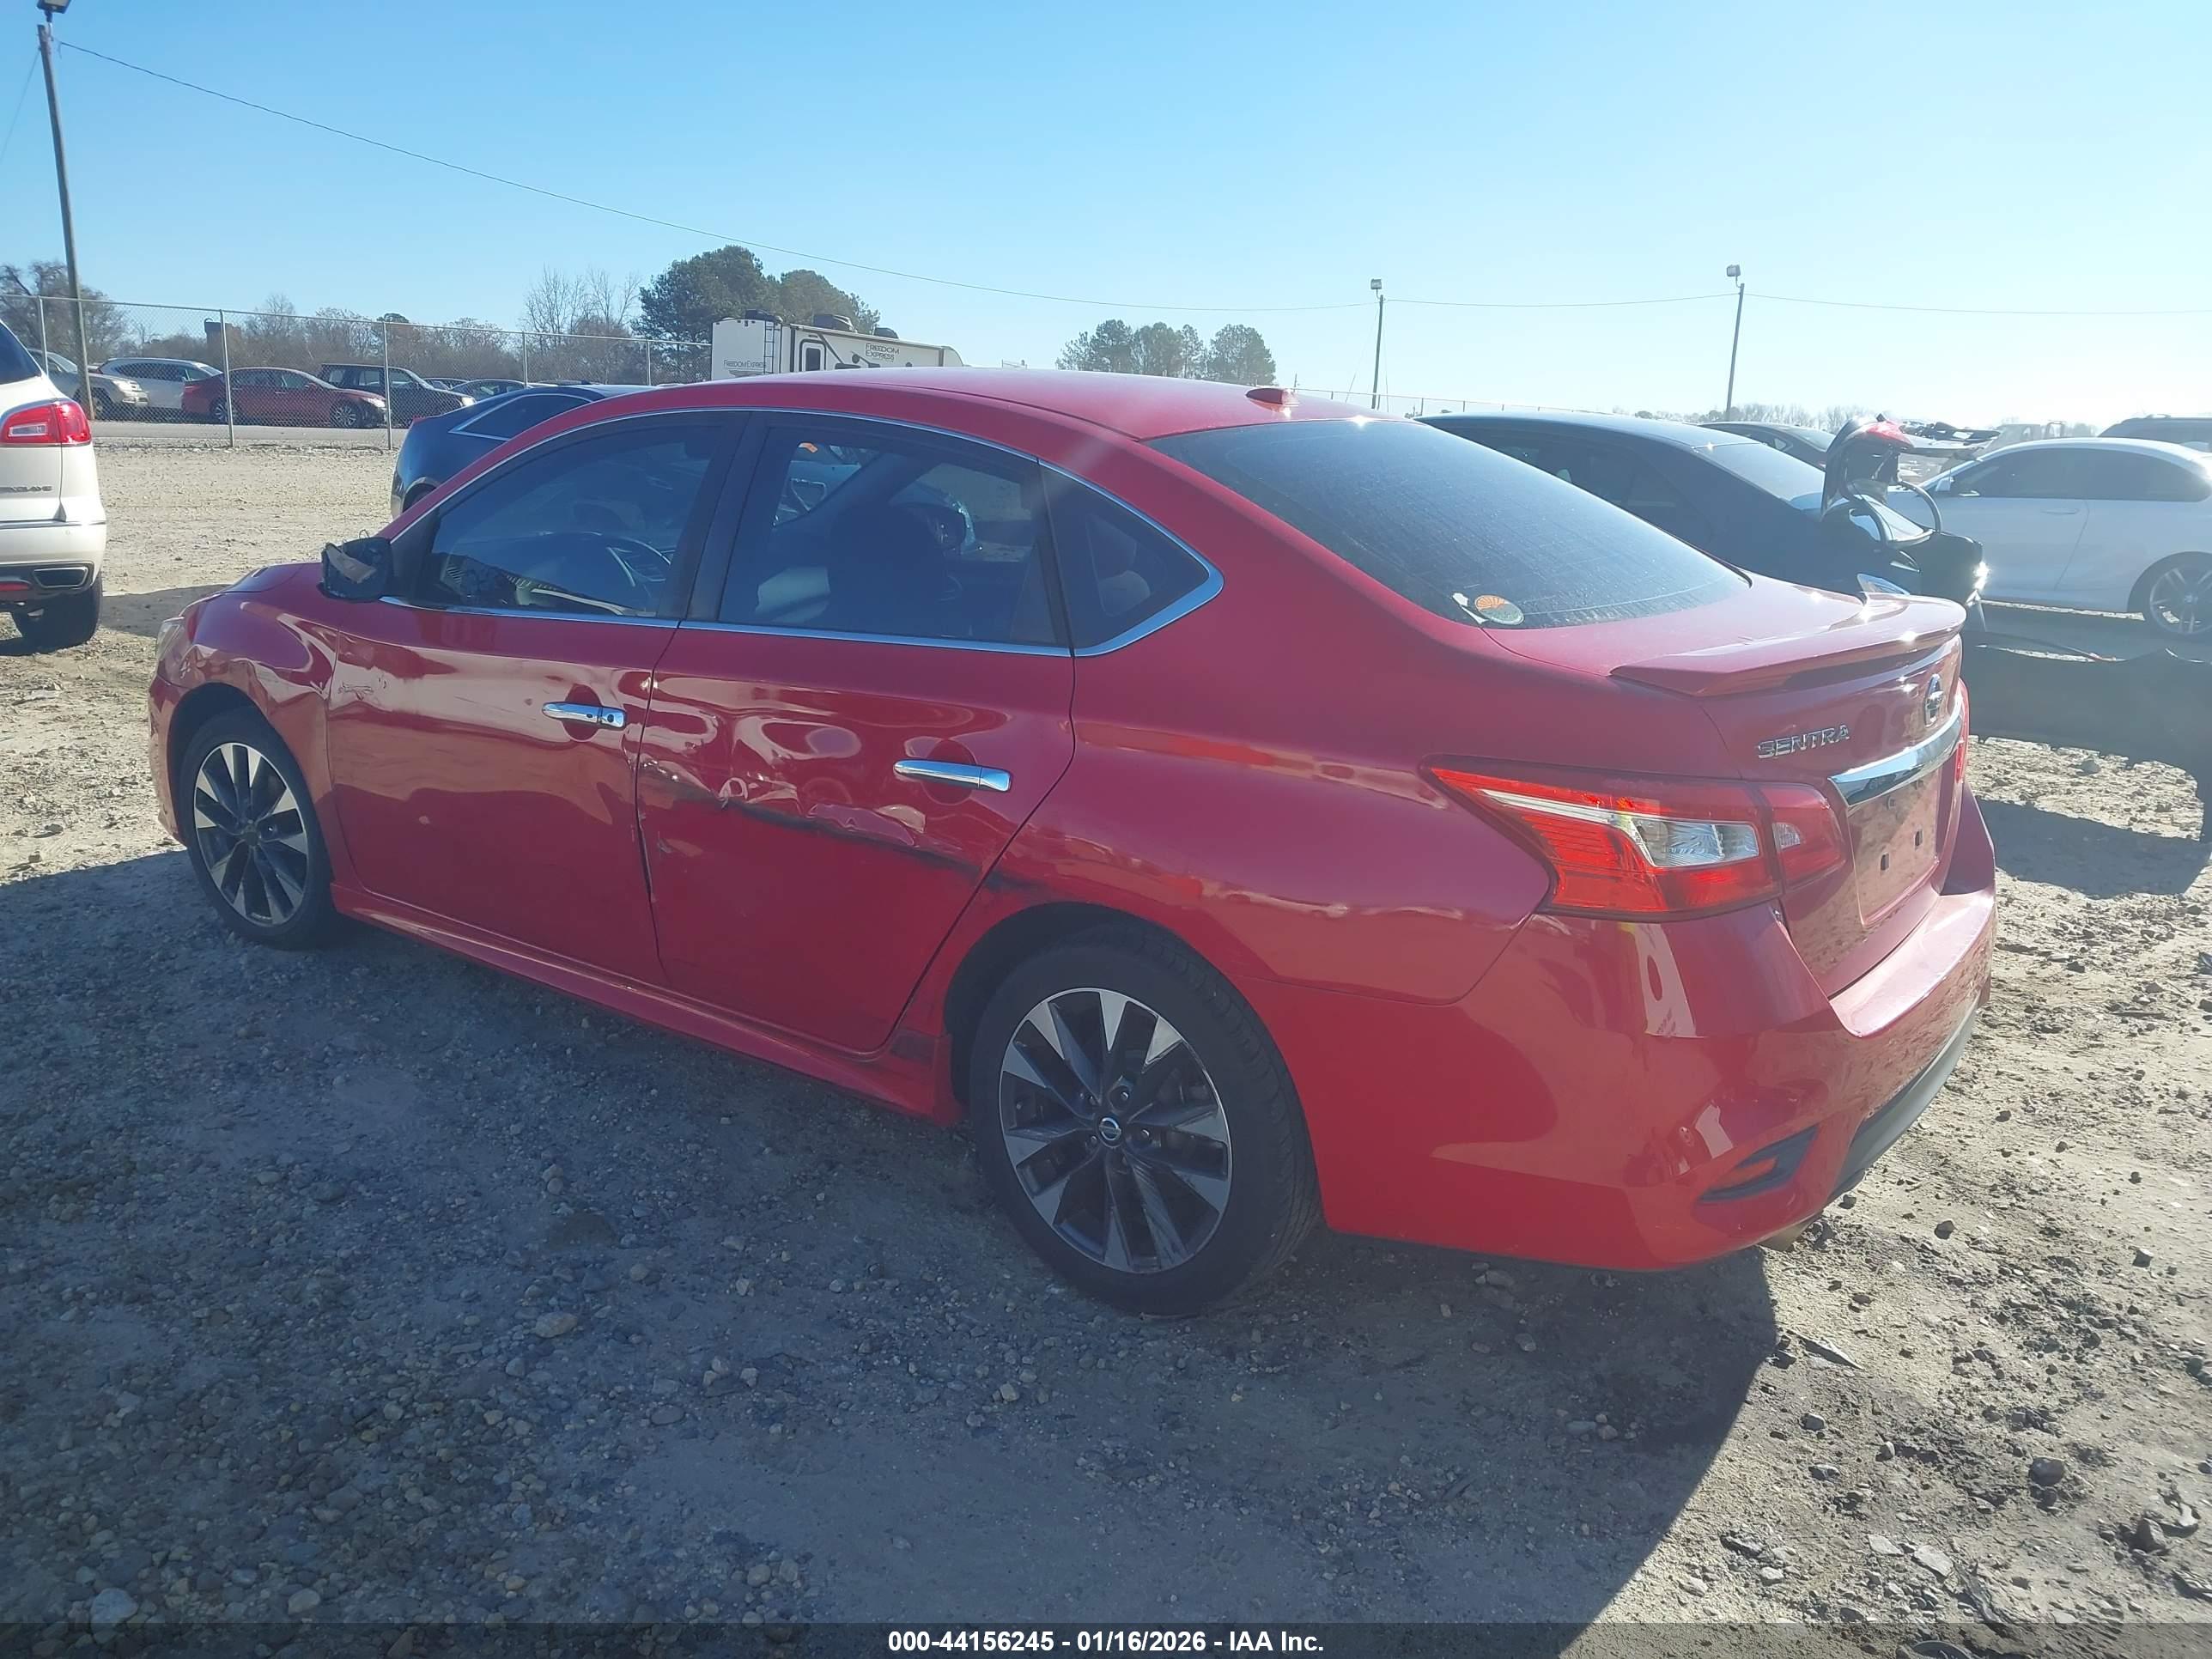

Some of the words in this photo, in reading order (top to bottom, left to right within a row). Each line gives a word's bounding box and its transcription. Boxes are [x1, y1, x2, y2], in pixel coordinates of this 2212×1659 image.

[866, 343, 900, 355] FREEDOM
[866, 350, 895, 361] EXPRESS
[1757, 724, 1850, 759] SENTRA
